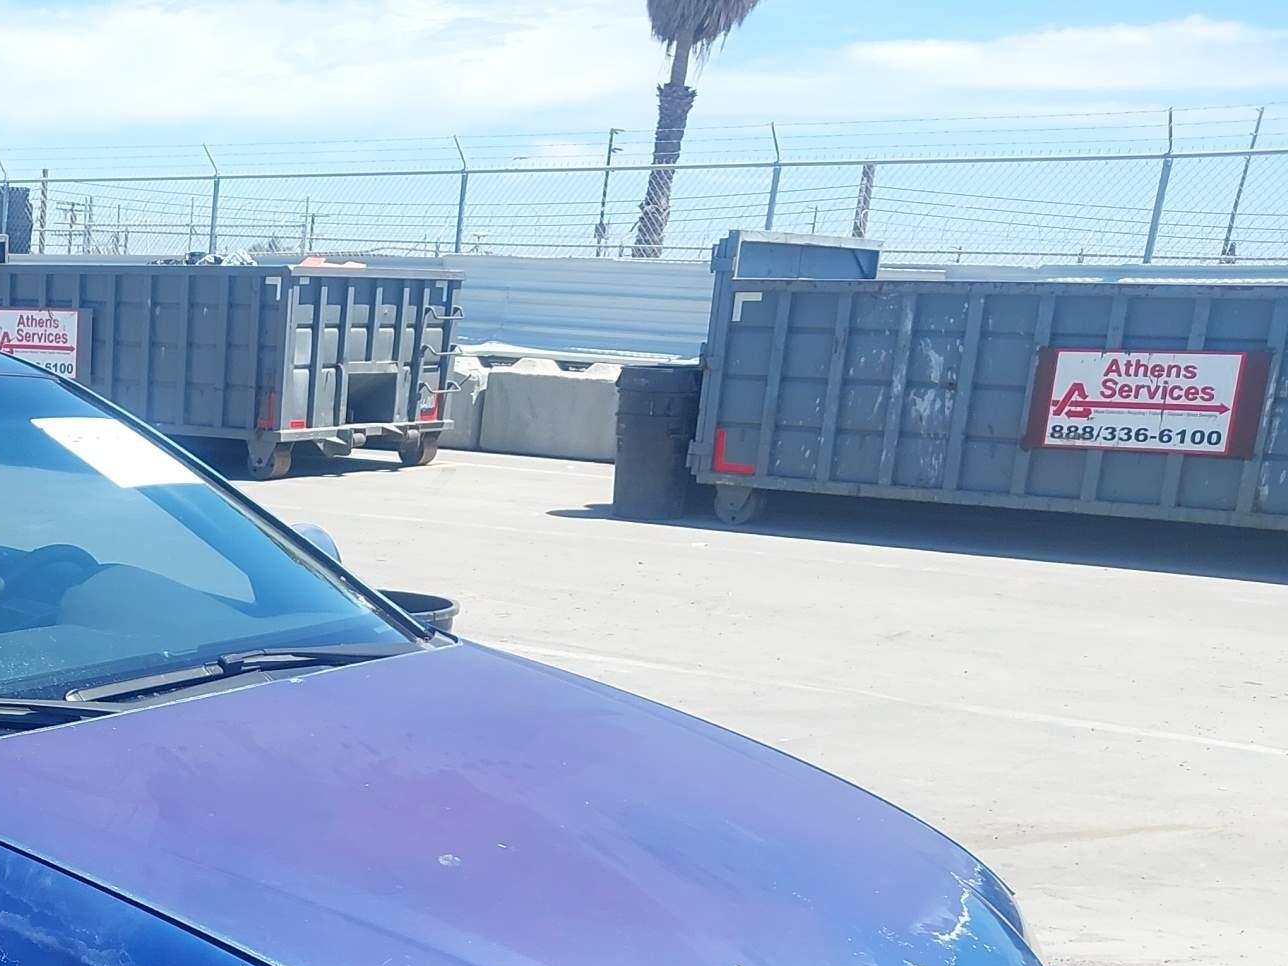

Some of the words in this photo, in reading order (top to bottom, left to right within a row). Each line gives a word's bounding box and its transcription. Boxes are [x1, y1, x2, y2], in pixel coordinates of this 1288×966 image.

[16, 314, 60, 329] Athens
[16, 328, 69, 344] Services
[1103, 358, 1198, 379] Athens
[1099, 378, 1216, 401] Services
[1050, 424, 1222, 446] 888/336-6100
